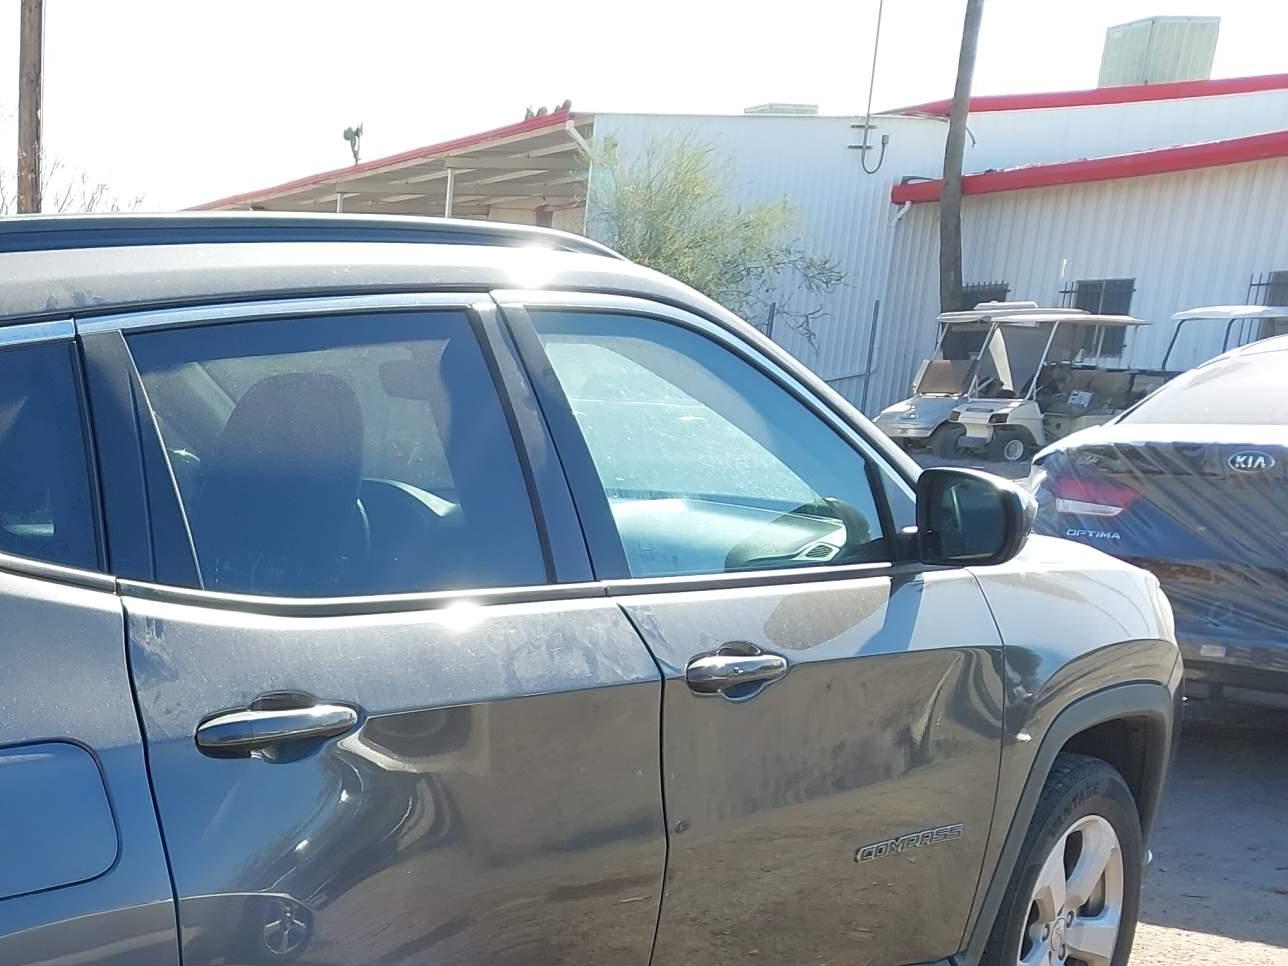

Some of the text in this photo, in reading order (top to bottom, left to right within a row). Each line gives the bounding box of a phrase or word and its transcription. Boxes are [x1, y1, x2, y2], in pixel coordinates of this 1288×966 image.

[1234, 455, 1266, 468] KIA
[1066, 528, 1121, 540] OPTIMA
[855, 823, 964, 863] COMPASS
